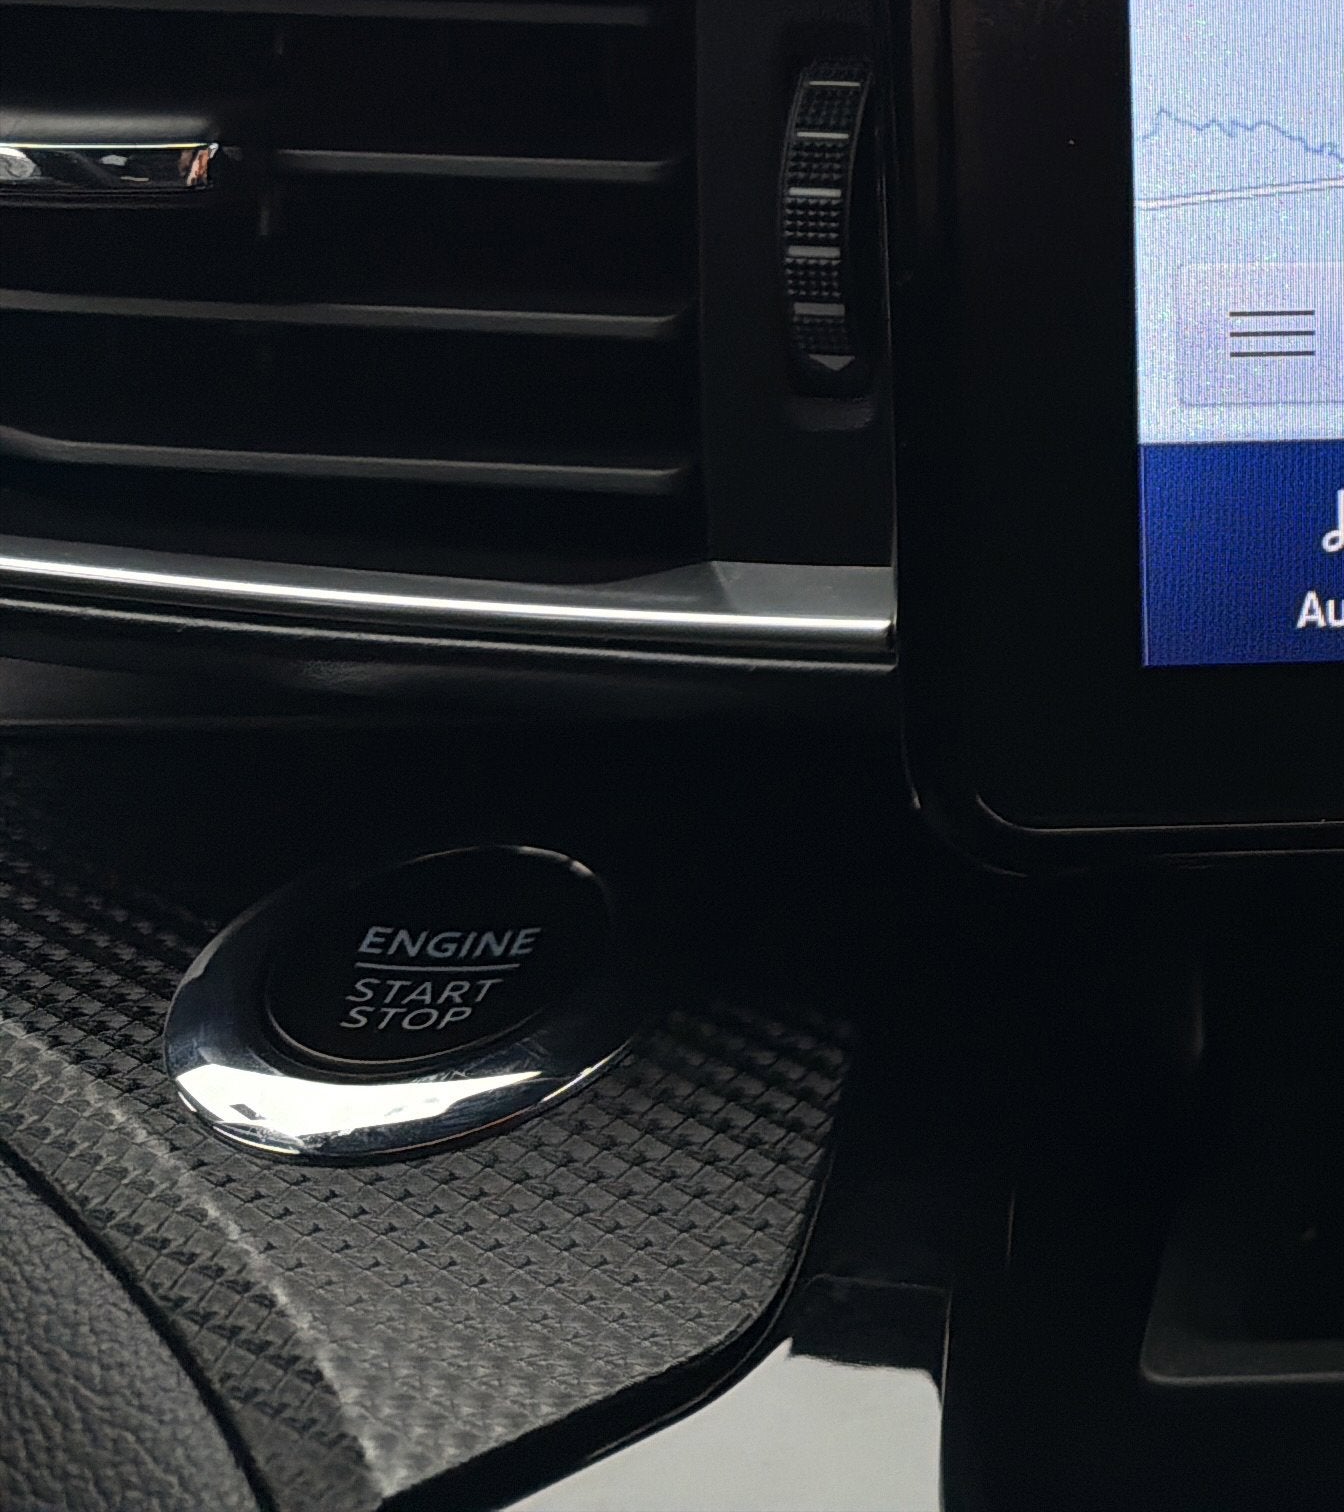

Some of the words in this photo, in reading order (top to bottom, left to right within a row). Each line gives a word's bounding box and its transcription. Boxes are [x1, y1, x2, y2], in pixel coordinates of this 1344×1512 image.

[357, 925, 542, 958] ENGINE
[345, 978, 503, 1005] START
[339, 1005, 473, 1030] STOP
